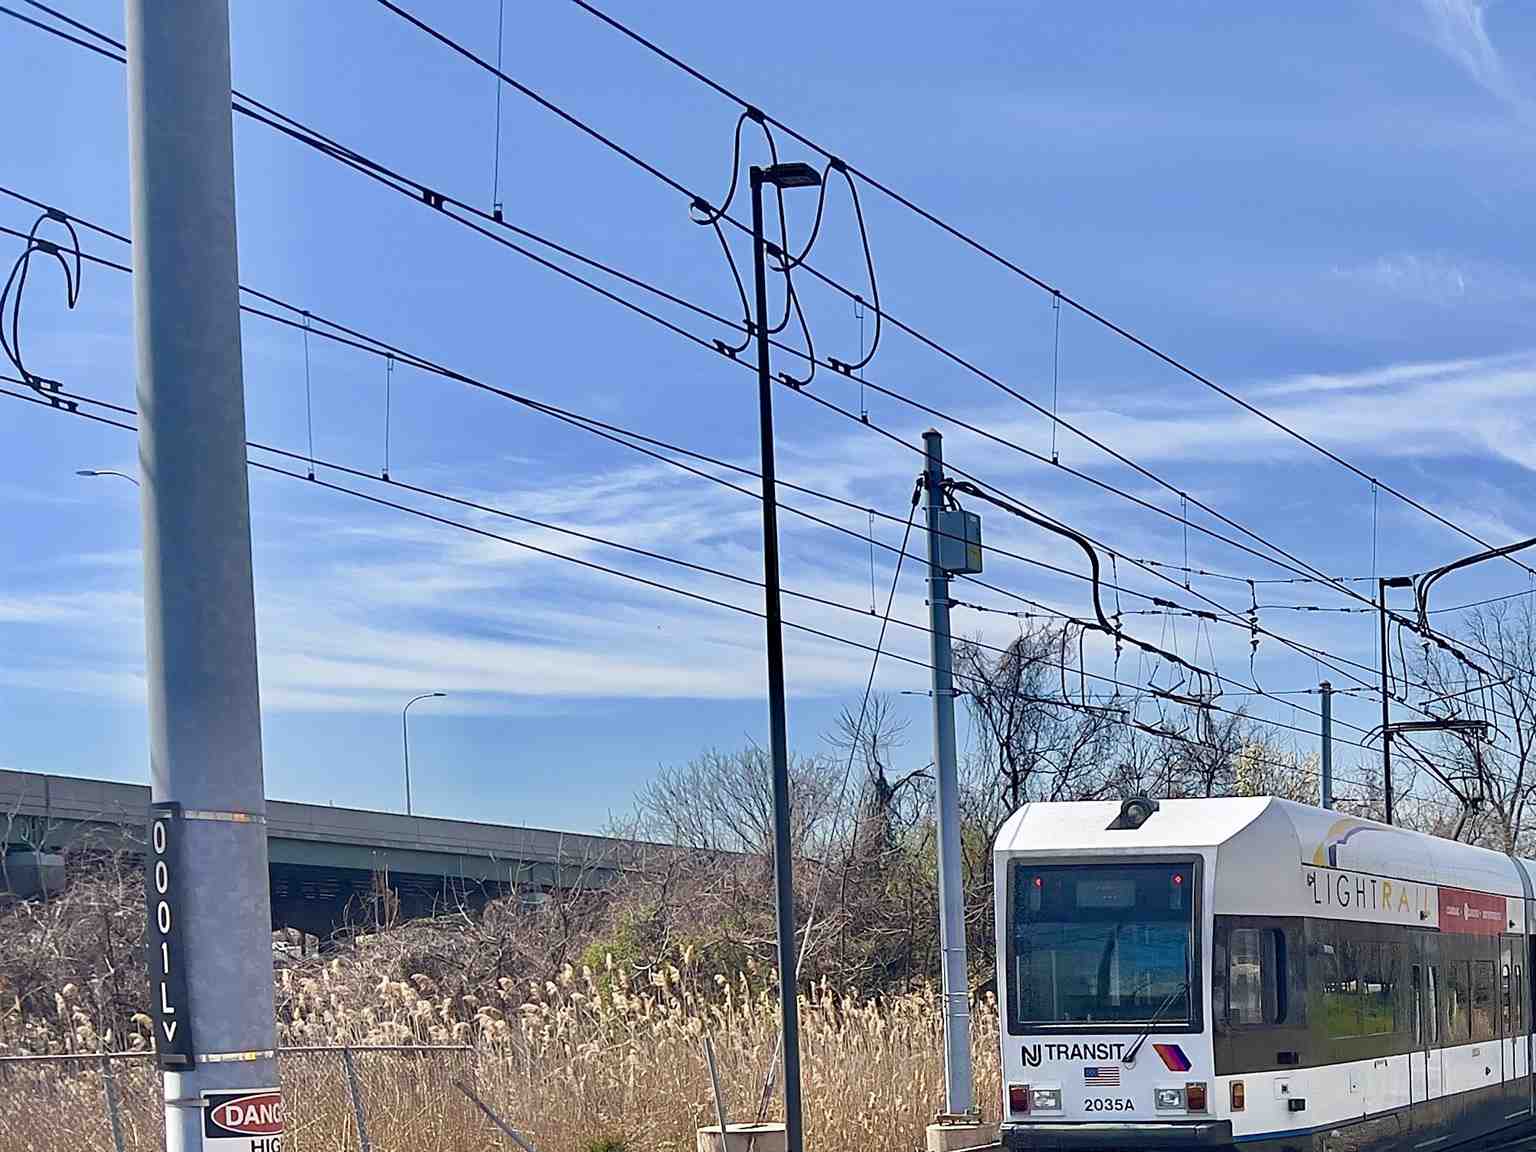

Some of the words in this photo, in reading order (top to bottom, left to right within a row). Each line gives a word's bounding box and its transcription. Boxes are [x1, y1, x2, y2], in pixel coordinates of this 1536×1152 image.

[1021, 1044, 1042, 1067] NJ
[1045, 1044, 1125, 1060] TRANSIT
[225, 1102, 281, 1127] DANG
[1084, 1098, 1135, 1112] 2035A
